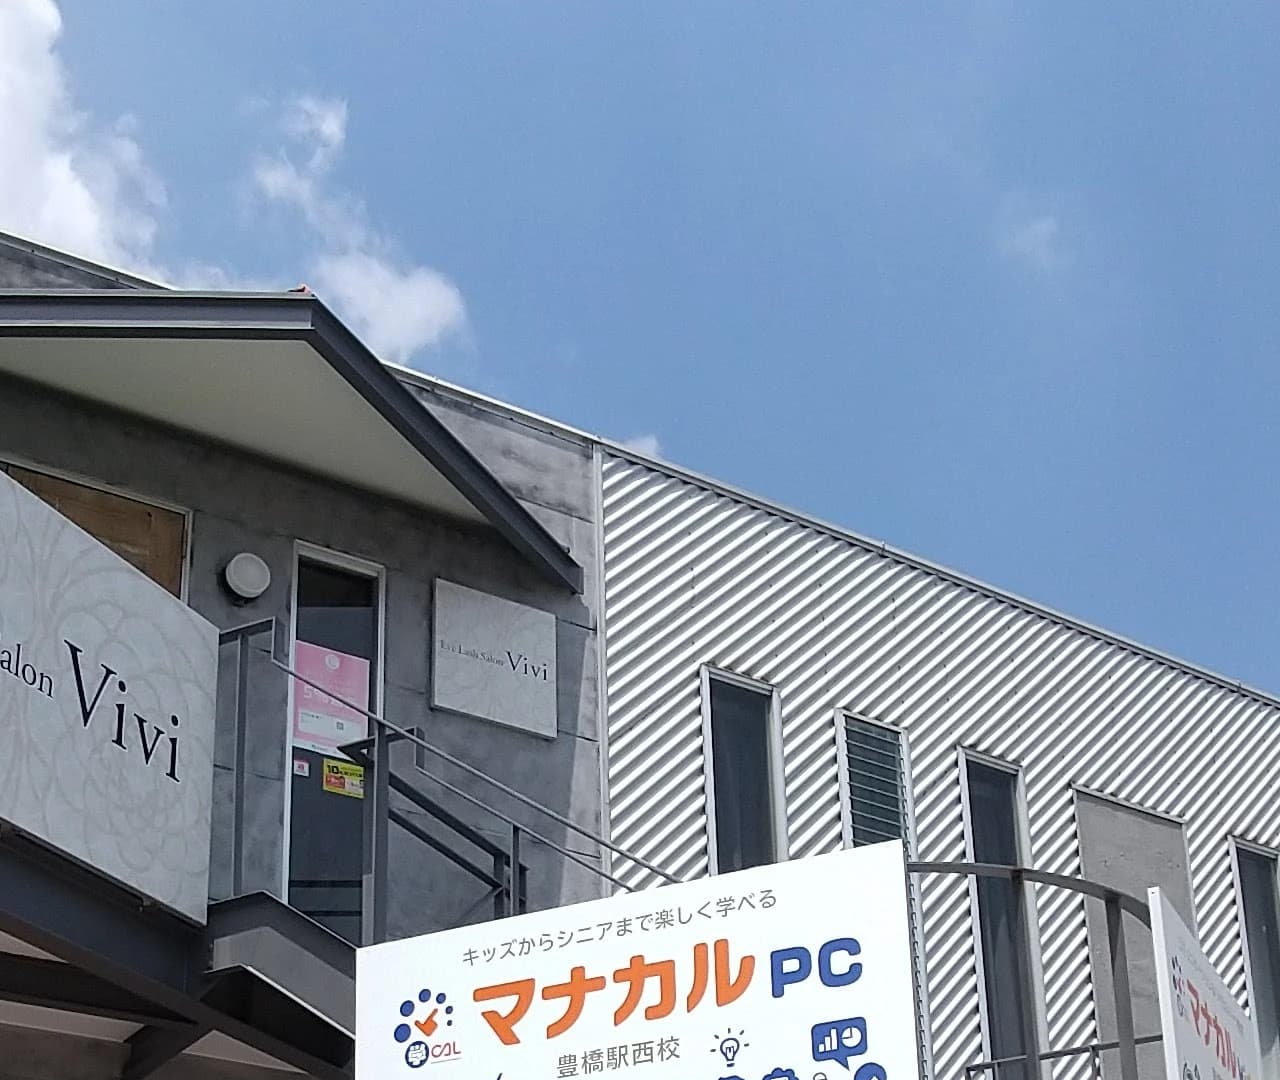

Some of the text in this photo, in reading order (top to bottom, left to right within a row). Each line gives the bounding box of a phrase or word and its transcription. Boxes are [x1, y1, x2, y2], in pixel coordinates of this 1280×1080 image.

[505, 650, 547, 681] Vivi
[63, 639, 181, 783] Vivi
[462, 889, 778, 967] キッズからシニアまで楽しく学べる
[473, 937, 863, 1046] マナカル PC
[556, 1036, 681, 1078] 豊橋駅西校
